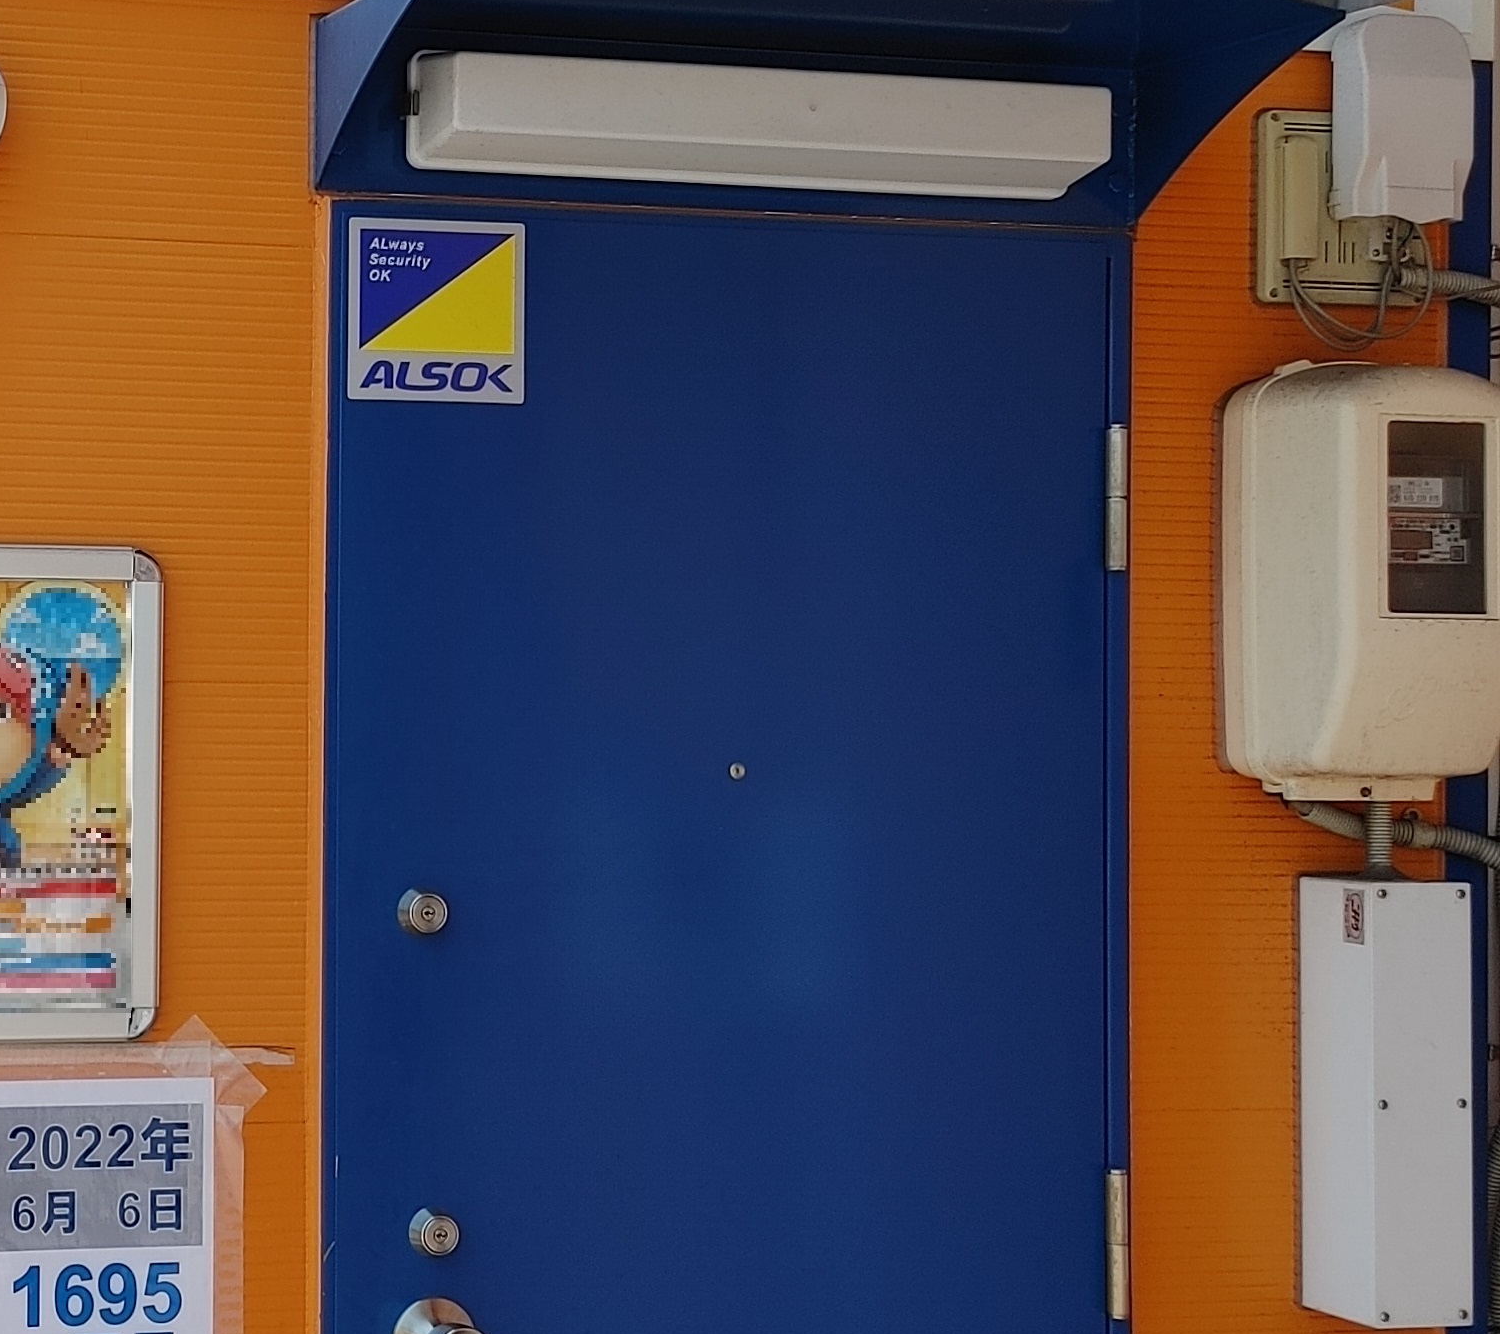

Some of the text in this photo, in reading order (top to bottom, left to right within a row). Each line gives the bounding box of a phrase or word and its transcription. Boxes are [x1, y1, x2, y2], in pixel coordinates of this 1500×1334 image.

[369, 238, 424, 251] ALways
[369, 254, 431, 270] Security
[369, 270, 391, 282] OK
[360, 360, 513, 393] ALSOK
[6, 1116, 195, 1174] 2022年
[10, 1188, 183, 1235] 6月 6日
[12, 1261, 183, 1328] 1695
